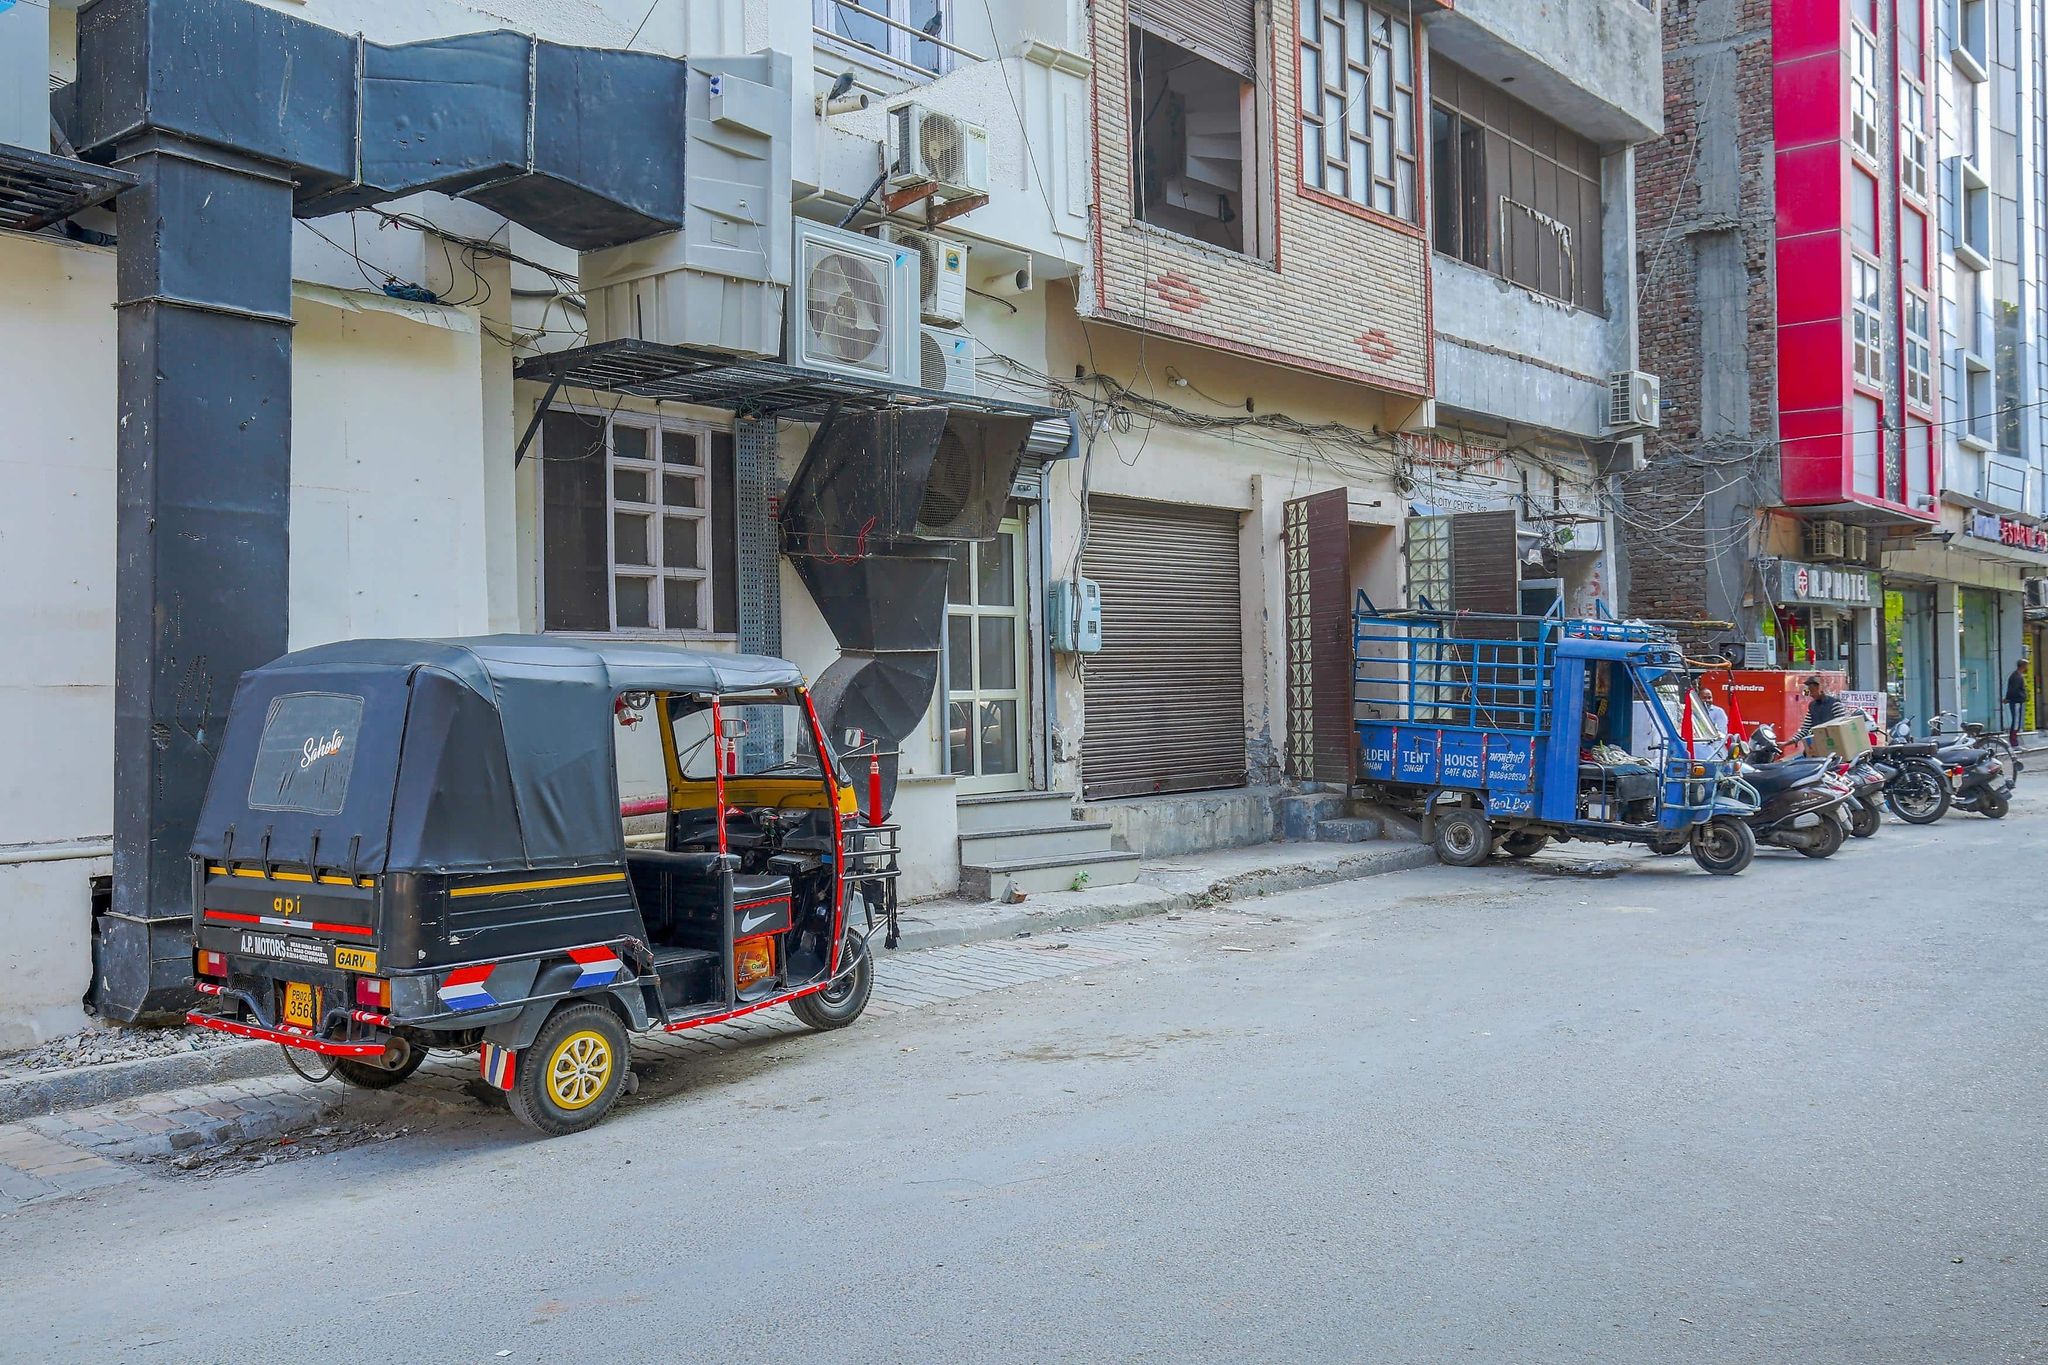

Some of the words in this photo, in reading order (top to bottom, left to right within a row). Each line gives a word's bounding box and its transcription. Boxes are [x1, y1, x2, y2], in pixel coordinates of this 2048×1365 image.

[1832, 572, 1871, 601] HOTEL
[301, 728, 345, 768] Sahota
[1403, 750, 1430, 764] TENT
[1444, 753, 1479, 768] HOUSE
[273, 895, 301, 917] api
[254, 936, 287, 958] MOTORS
[338, 952, 366, 967] GARV
